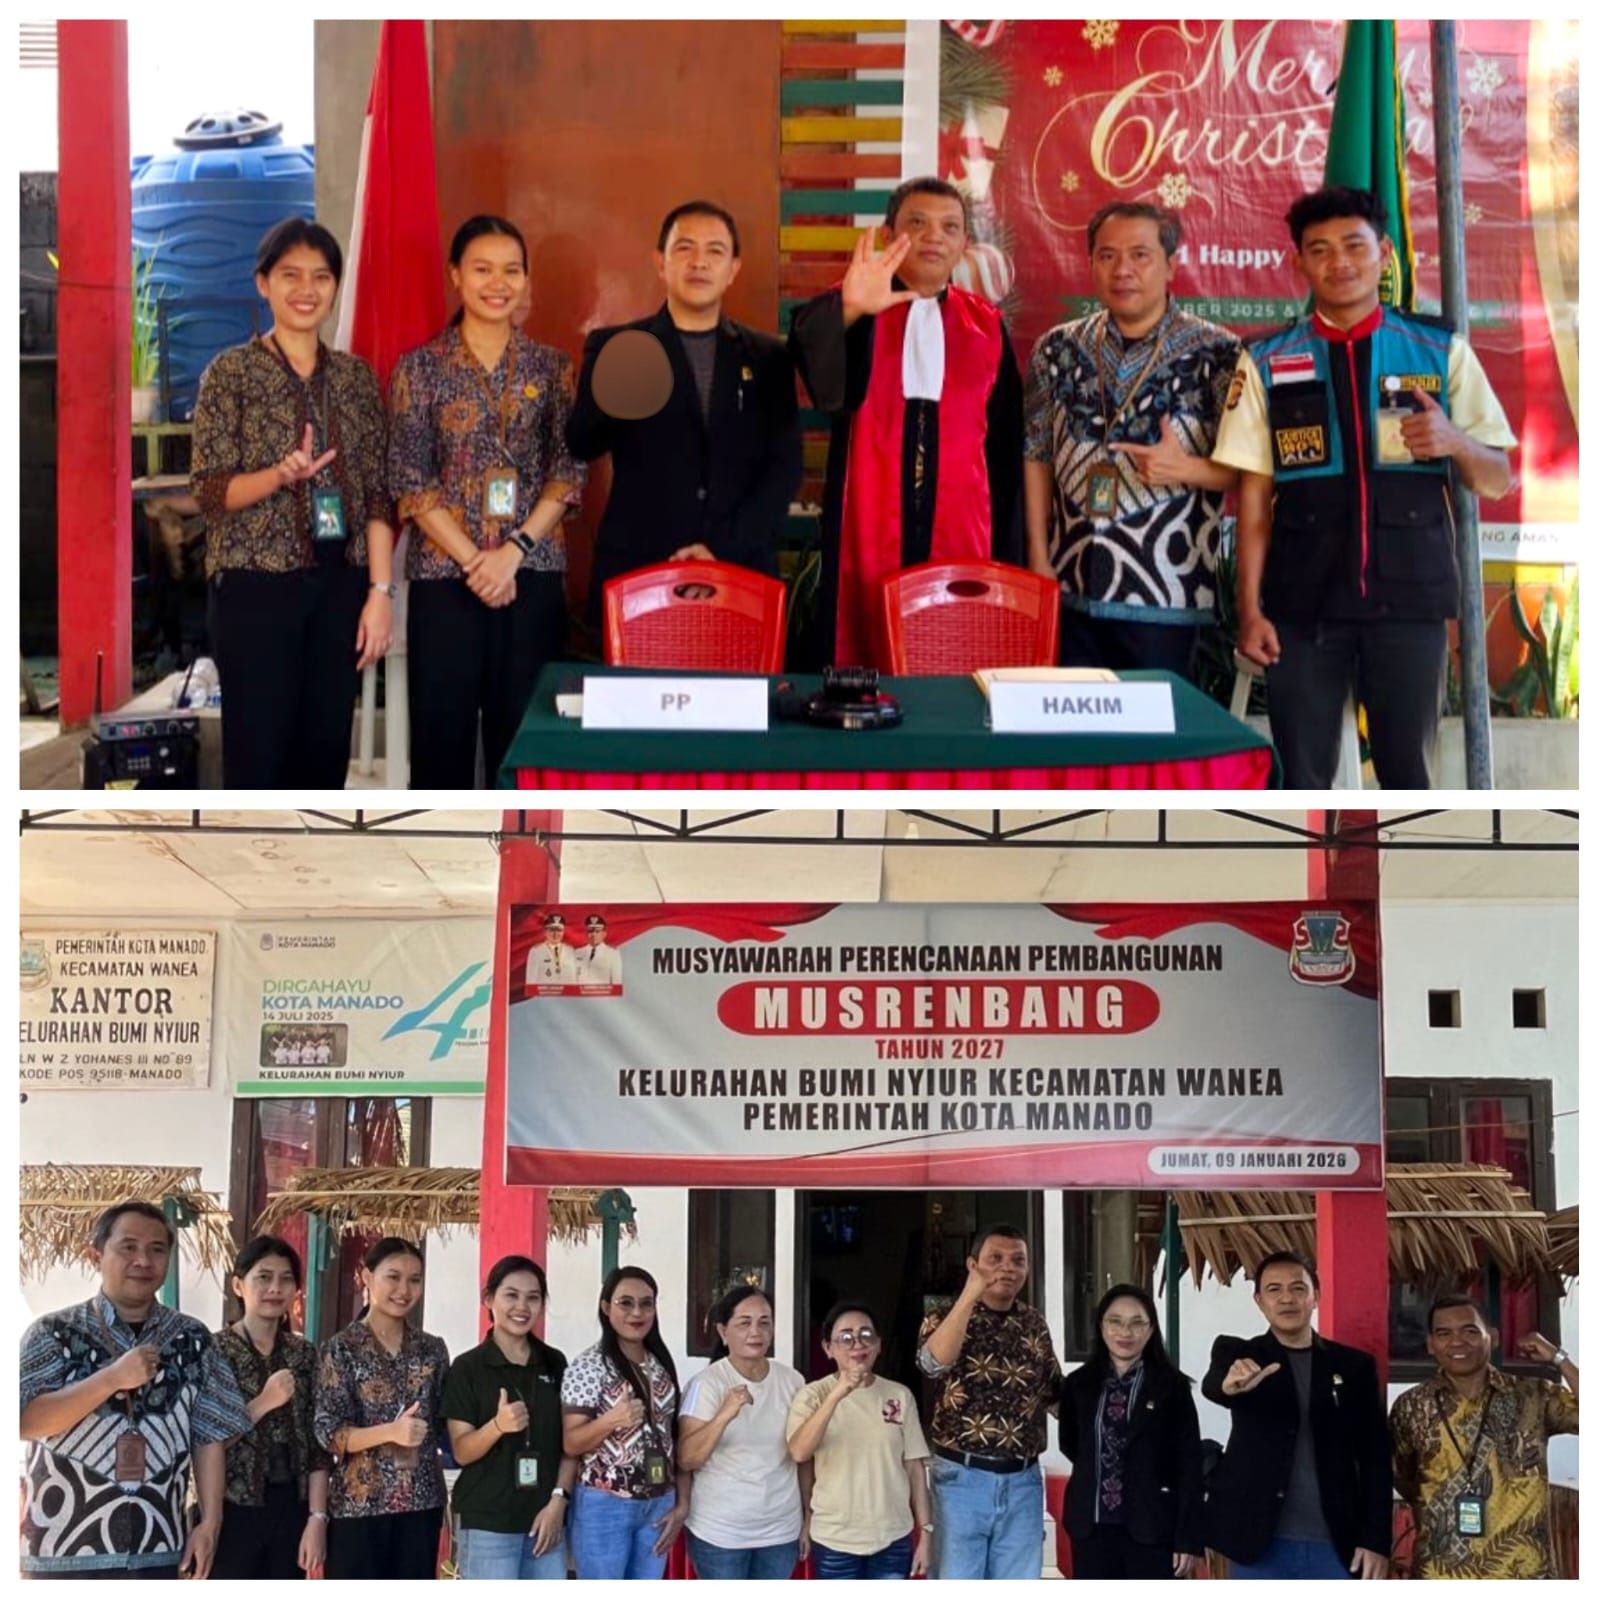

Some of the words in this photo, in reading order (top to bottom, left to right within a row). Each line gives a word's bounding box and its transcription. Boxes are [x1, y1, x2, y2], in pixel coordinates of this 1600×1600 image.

[1090, 72, 1440, 189] Christa
[1200, 245, 1287, 270] Happy
[1230, 303, 1275, 318] 2025
[661, 693, 691, 711] PP
[1042, 697, 1123, 715] HAKIM
[56, 939, 125, 954] PEMERINTAH
[128, 939, 156, 954] KOTA
[652, 946, 832, 974] MUSYAWARAH
[840, 945, 1021, 973] PERENCANAAN
[1028, 944, 1223, 972] PEMBANGUNAN
[60, 961, 144, 977] KECAMATAN
[150, 961, 199, 977] WANEA
[263, 979, 371, 993] DIRGAHAYU
[49, 987, 173, 1015] KANTOR
[262, 996, 312, 1010] KOTA
[317, 996, 404, 1010] MANADO
[754, 985, 1125, 1030] MUSRENBANG
[263, 1011, 275, 1021] 14
[278, 1011, 303, 1021] JULI
[307, 1011, 334, 1021] 2025
[19, 1021, 101, 1043] ELURAHAN
[109, 1021, 147, 1043] BUMI
[154, 1021, 199, 1043] NYIUR
[875, 1038, 943, 1060] TAHUN
[952, 1038, 1005, 1060] 2027
[19, 1054, 36, 1064] LN
[42, 1054, 54, 1064] W
[75, 1054, 132, 1065] YOHANES
[19, 1068, 53, 1079] KODE
[59, 1068, 84, 1079] POS
[259, 1070, 332, 1079] KELURAHAN
[335, 1070, 365, 1079] BUMI
[368, 1070, 404, 1079] NYIUR
[618, 1069, 787, 1098] KELURAHAN
[800, 1069, 877, 1097] BUMI
[888, 1068, 978, 1097] NYIUR
[988, 1067, 1166, 1097] KECAMATAN
[1176, 1067, 1284, 1097] WANEA
[743, 1102, 929, 1131] PEMERINTAH
[940, 1102, 1015, 1131] KOTA
[1025, 1102, 1154, 1131] MANADO
[1160, 1152, 1211, 1169] JUMAT,
[1215, 1152, 1235, 1168] 09
[1239, 1152, 1303, 1168] JANUARI
[1306, 1152, 1347, 1169] 2026
